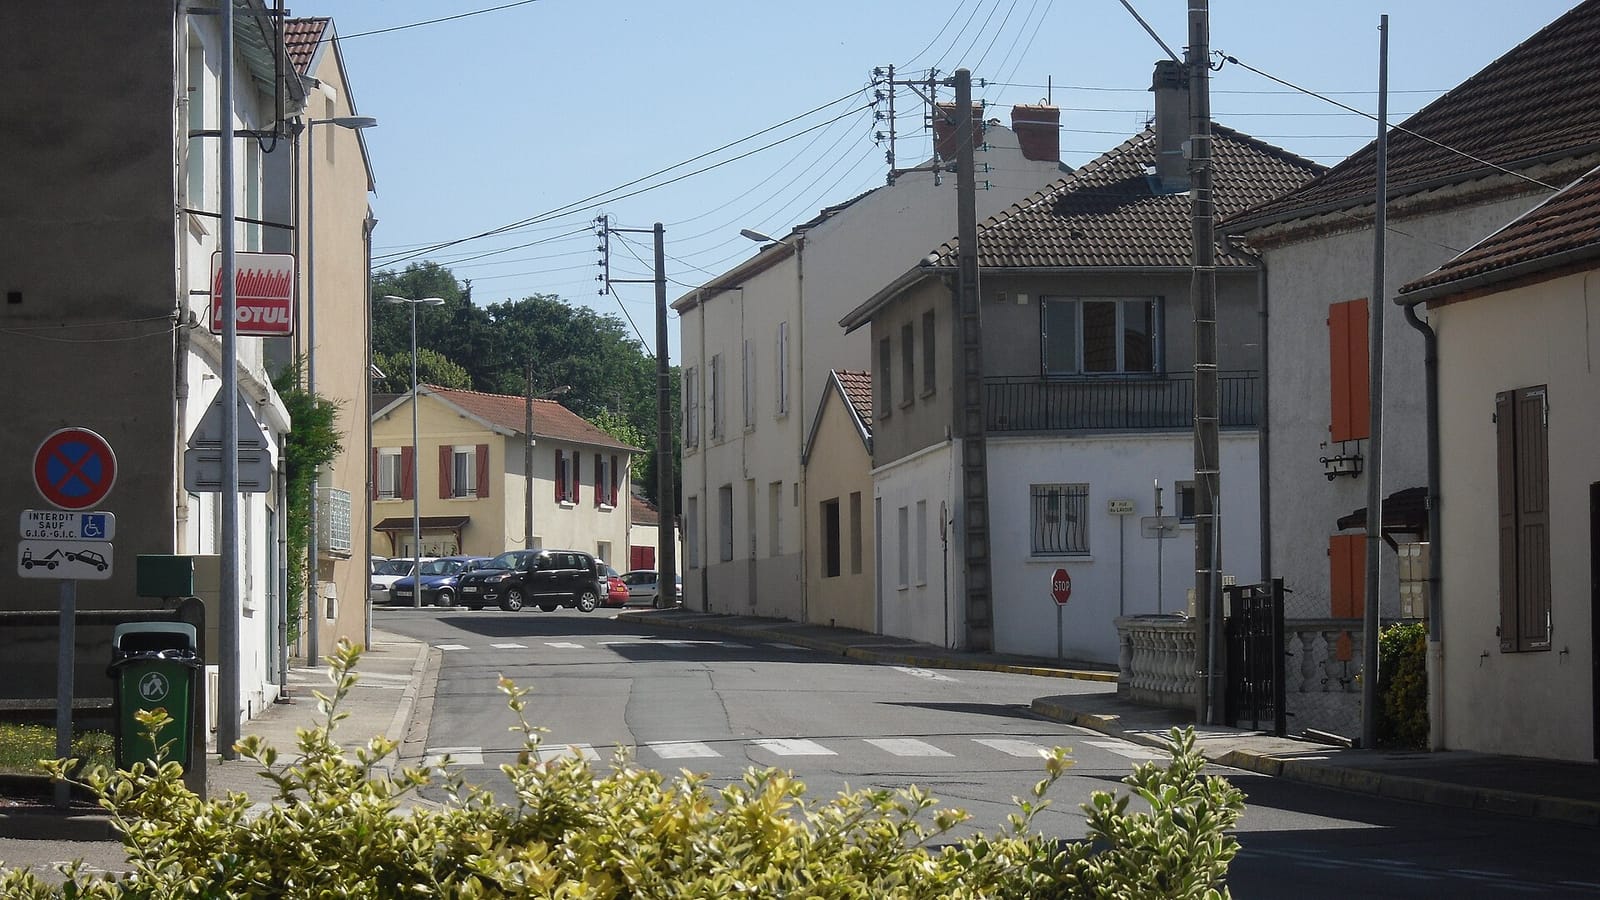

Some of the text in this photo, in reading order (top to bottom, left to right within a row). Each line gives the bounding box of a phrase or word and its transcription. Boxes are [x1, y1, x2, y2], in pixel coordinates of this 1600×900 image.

[29, 512, 75, 521] INTERDIT
[39, 521, 65, 530] SAUF
[1054, 580, 1070, 592] STOP
